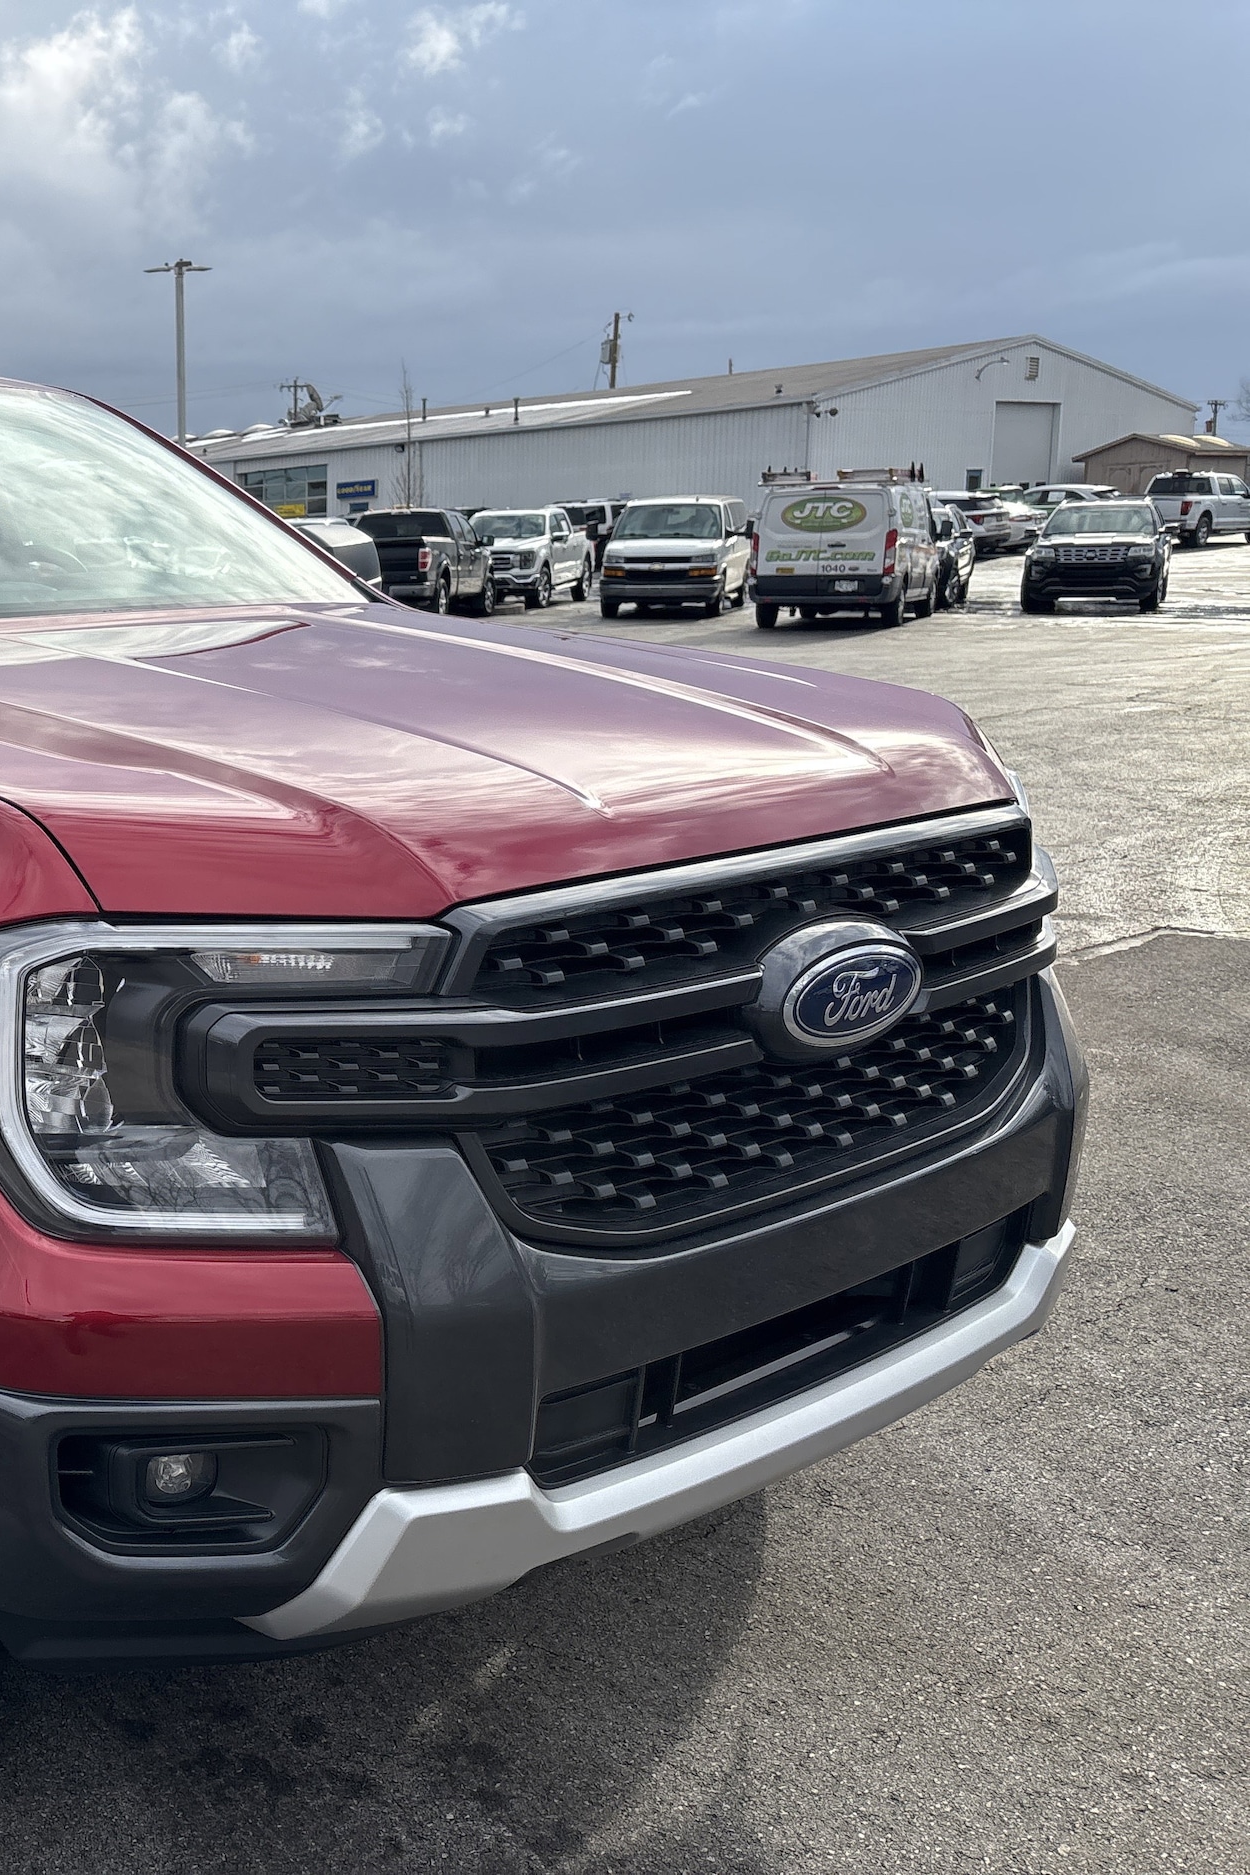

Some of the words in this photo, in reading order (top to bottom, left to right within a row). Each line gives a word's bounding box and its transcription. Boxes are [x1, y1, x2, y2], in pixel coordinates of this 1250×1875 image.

[793, 501, 854, 519] JTC
[821, 564, 846, 574] 1040
[823, 966, 897, 1027] Ford
